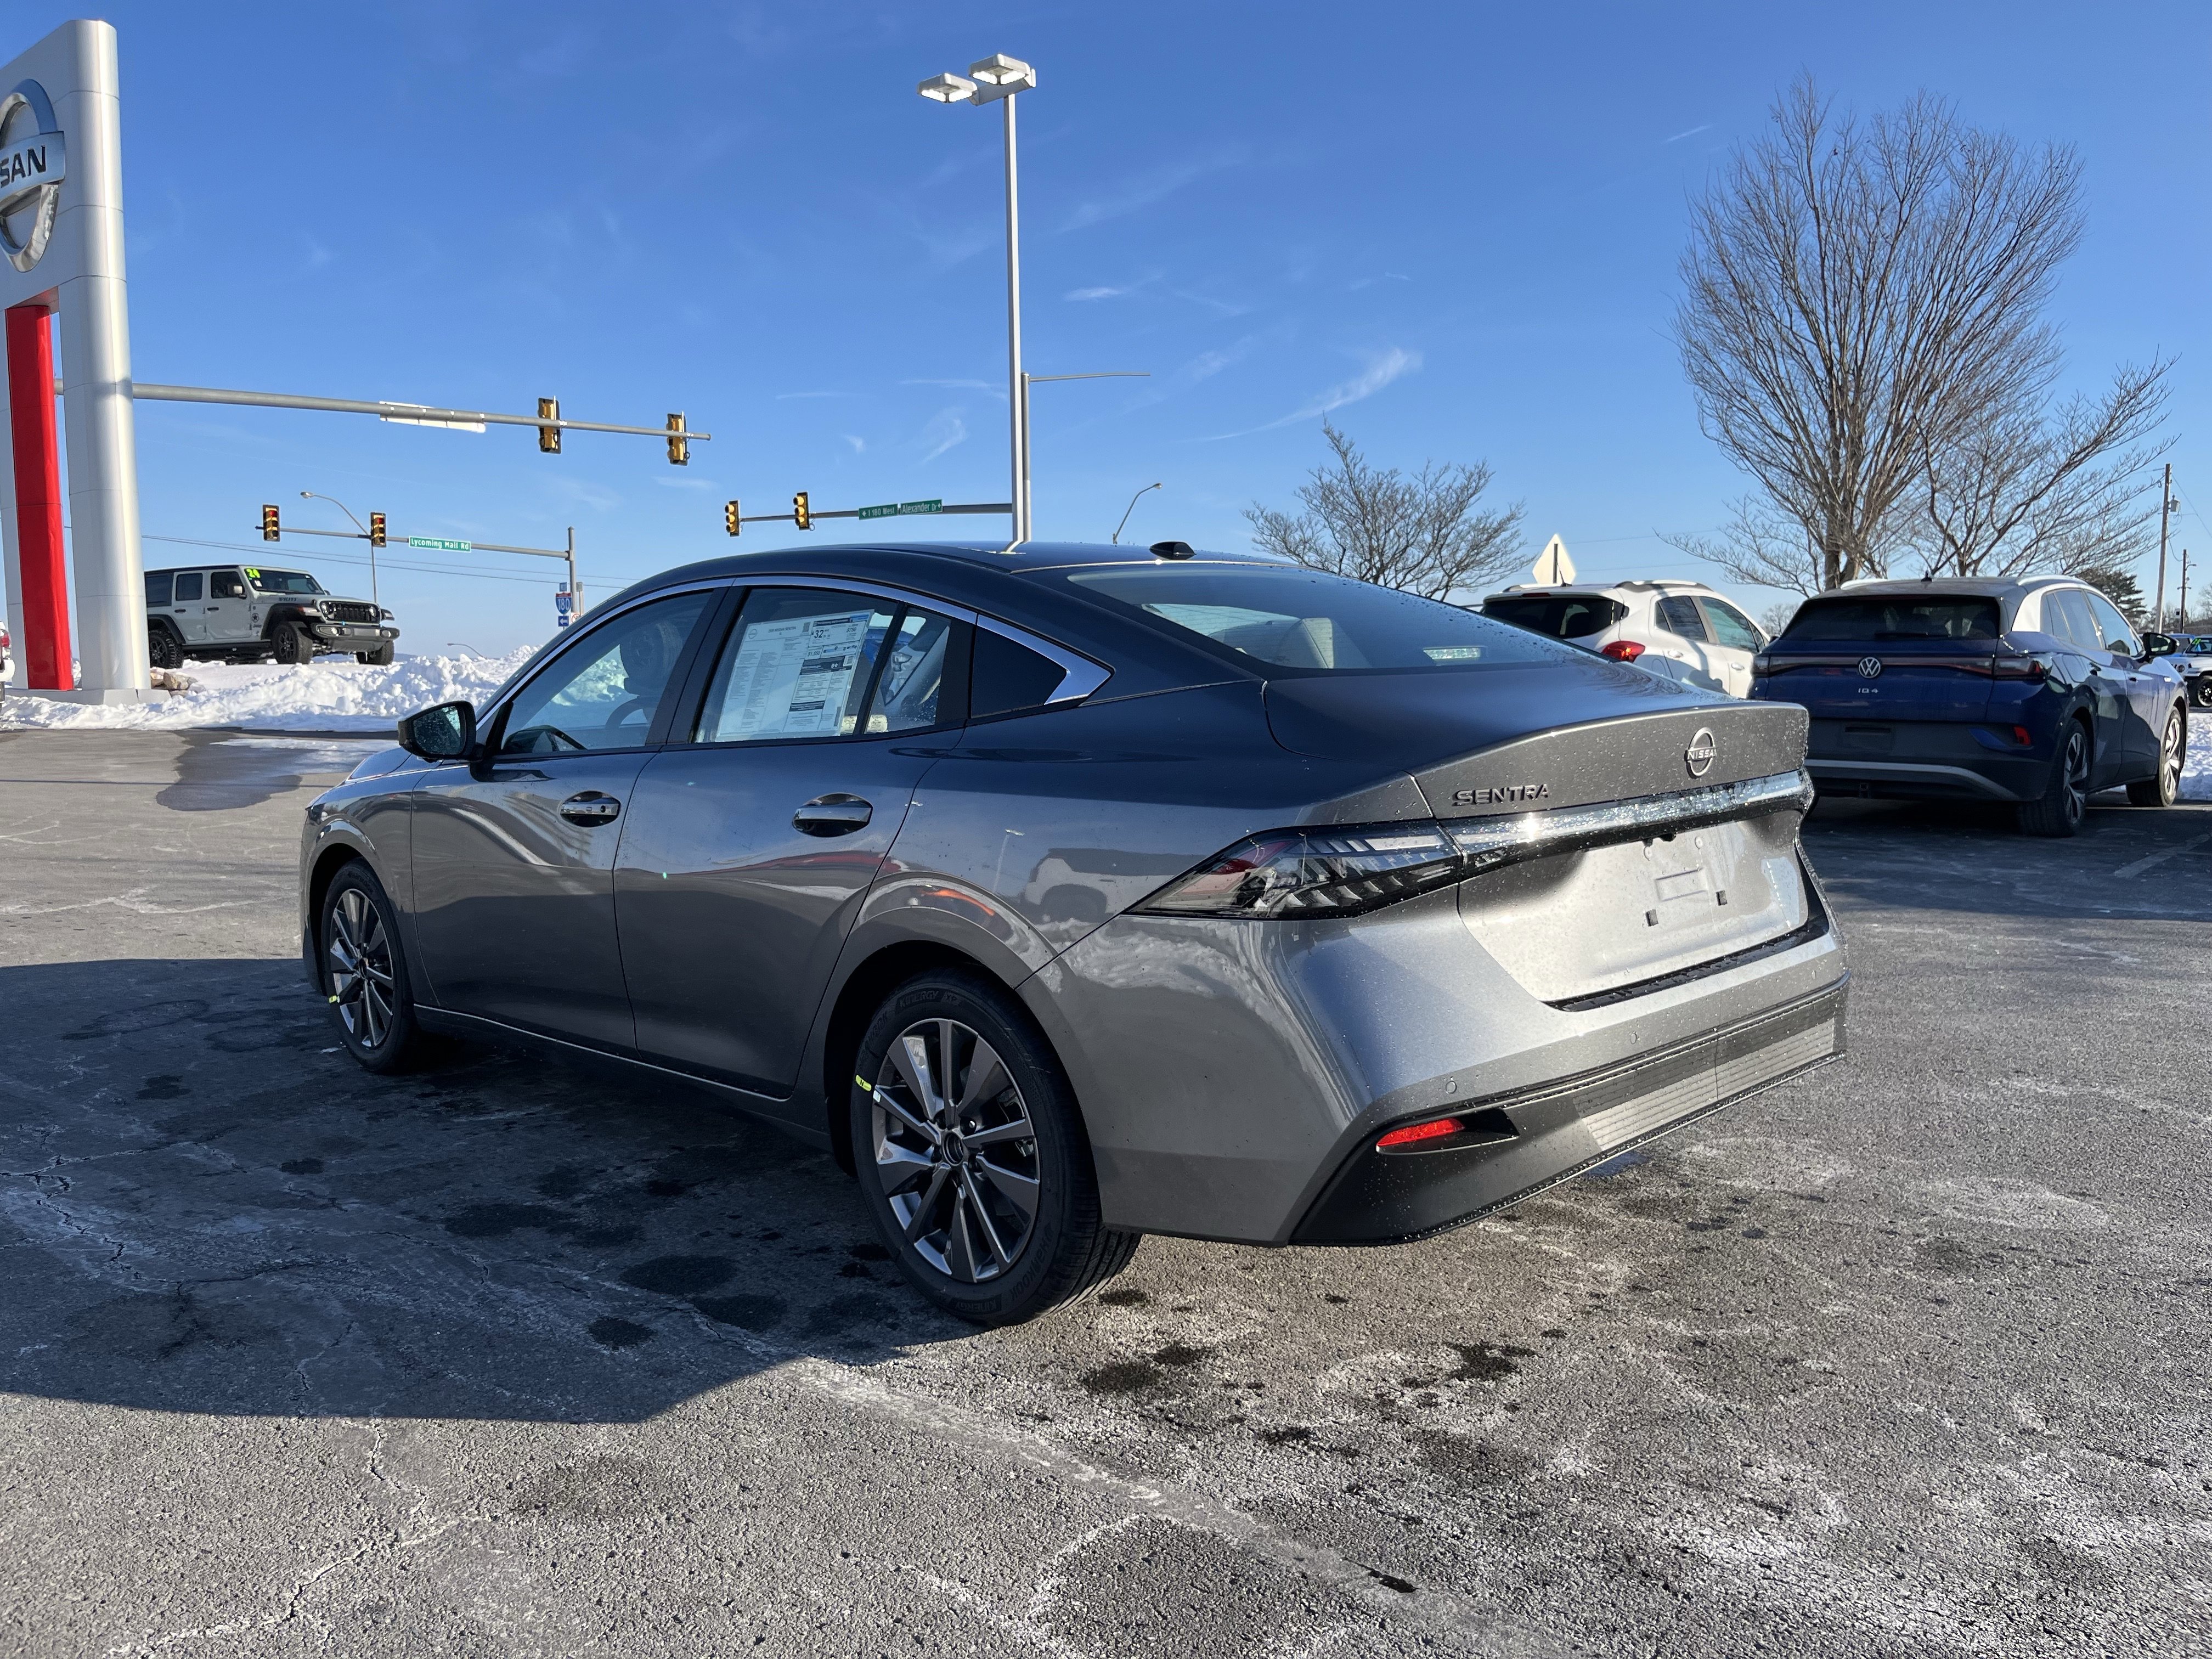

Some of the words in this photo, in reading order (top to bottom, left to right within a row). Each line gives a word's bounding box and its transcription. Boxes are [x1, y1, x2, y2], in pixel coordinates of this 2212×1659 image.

[872, 508, 881, 517] 180
[883, 507, 895, 515] West
[901, 502, 930, 514] Alexander
[932, 503, 937, 511] Dr
[411, 538, 442, 549] Lycoming
[444, 541, 459, 549] Mall
[558, 598, 570, 611] 180
[814, 629, 824, 639] 32
[1687, 748, 1717, 760] NISSAN
[1453, 784, 1549, 806] SENTRA
